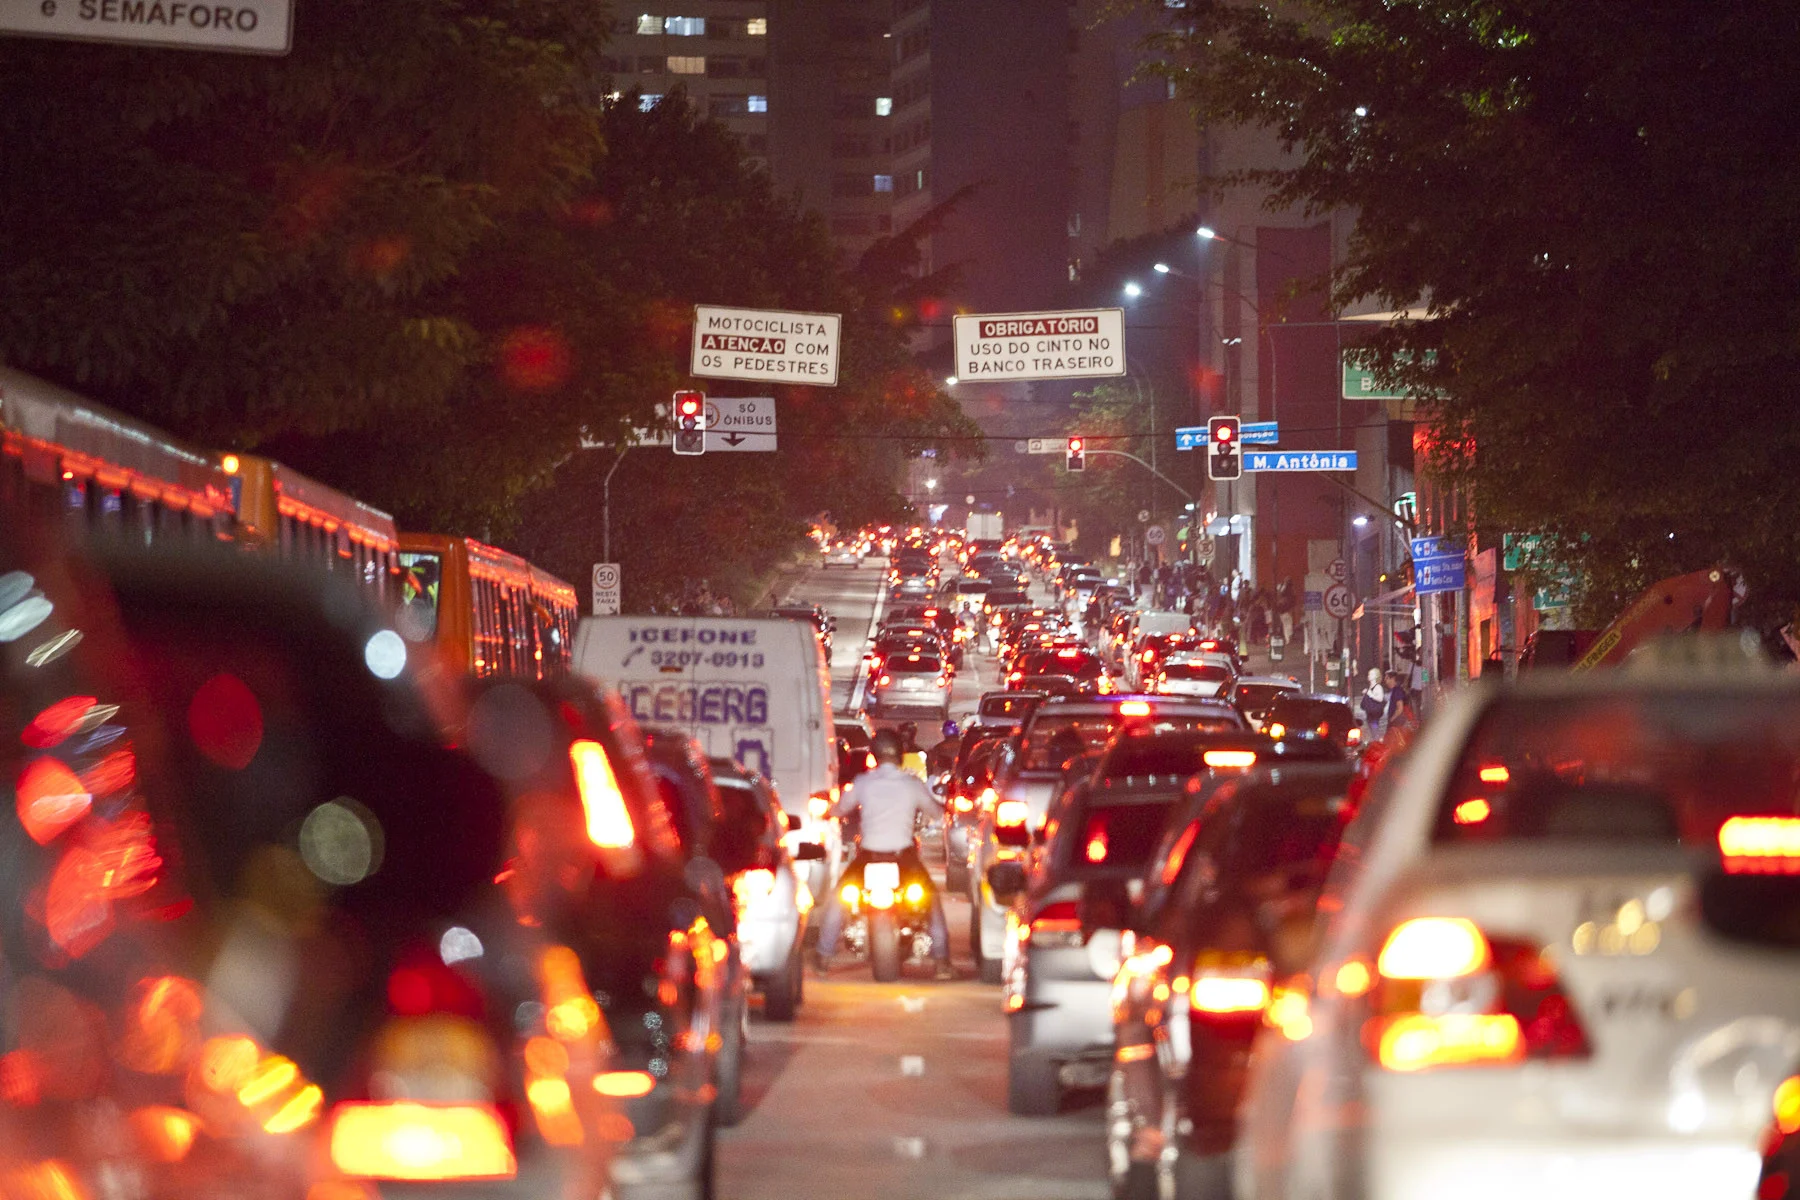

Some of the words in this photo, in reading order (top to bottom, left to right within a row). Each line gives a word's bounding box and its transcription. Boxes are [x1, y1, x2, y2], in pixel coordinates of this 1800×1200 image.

[41, 0, 56, 17] e
[79, 0, 258, 32] SEMAFORO
[708, 316, 827, 336] MOTOCICLISTA
[984, 318, 1096, 336] OBRIGATÓRIO
[703, 335, 785, 354] ATENÇÃO
[795, 342, 829, 356] COM
[970, 343, 1002, 355] USO
[1009, 342, 1030, 354] DO
[1037, 339, 1083, 352] CINTO
[1089, 338, 1110, 350] NO
[701, 355, 722, 368] OS
[733, 357, 829, 375] PEDESTRES
[969, 360, 1025, 373] BANCO
[1032, 356, 1114, 371] TRASEIRO
[739, 402, 756, 413] SÓ
[723, 414, 773, 426] ÔNIBUS
[1253, 455, 1271, 469] M.
[1276, 453, 1348, 469] Antônia
[599, 571, 614, 582] 50
[1330, 593, 1350, 607] 60
[624, 685, 768, 724] CEBERG
